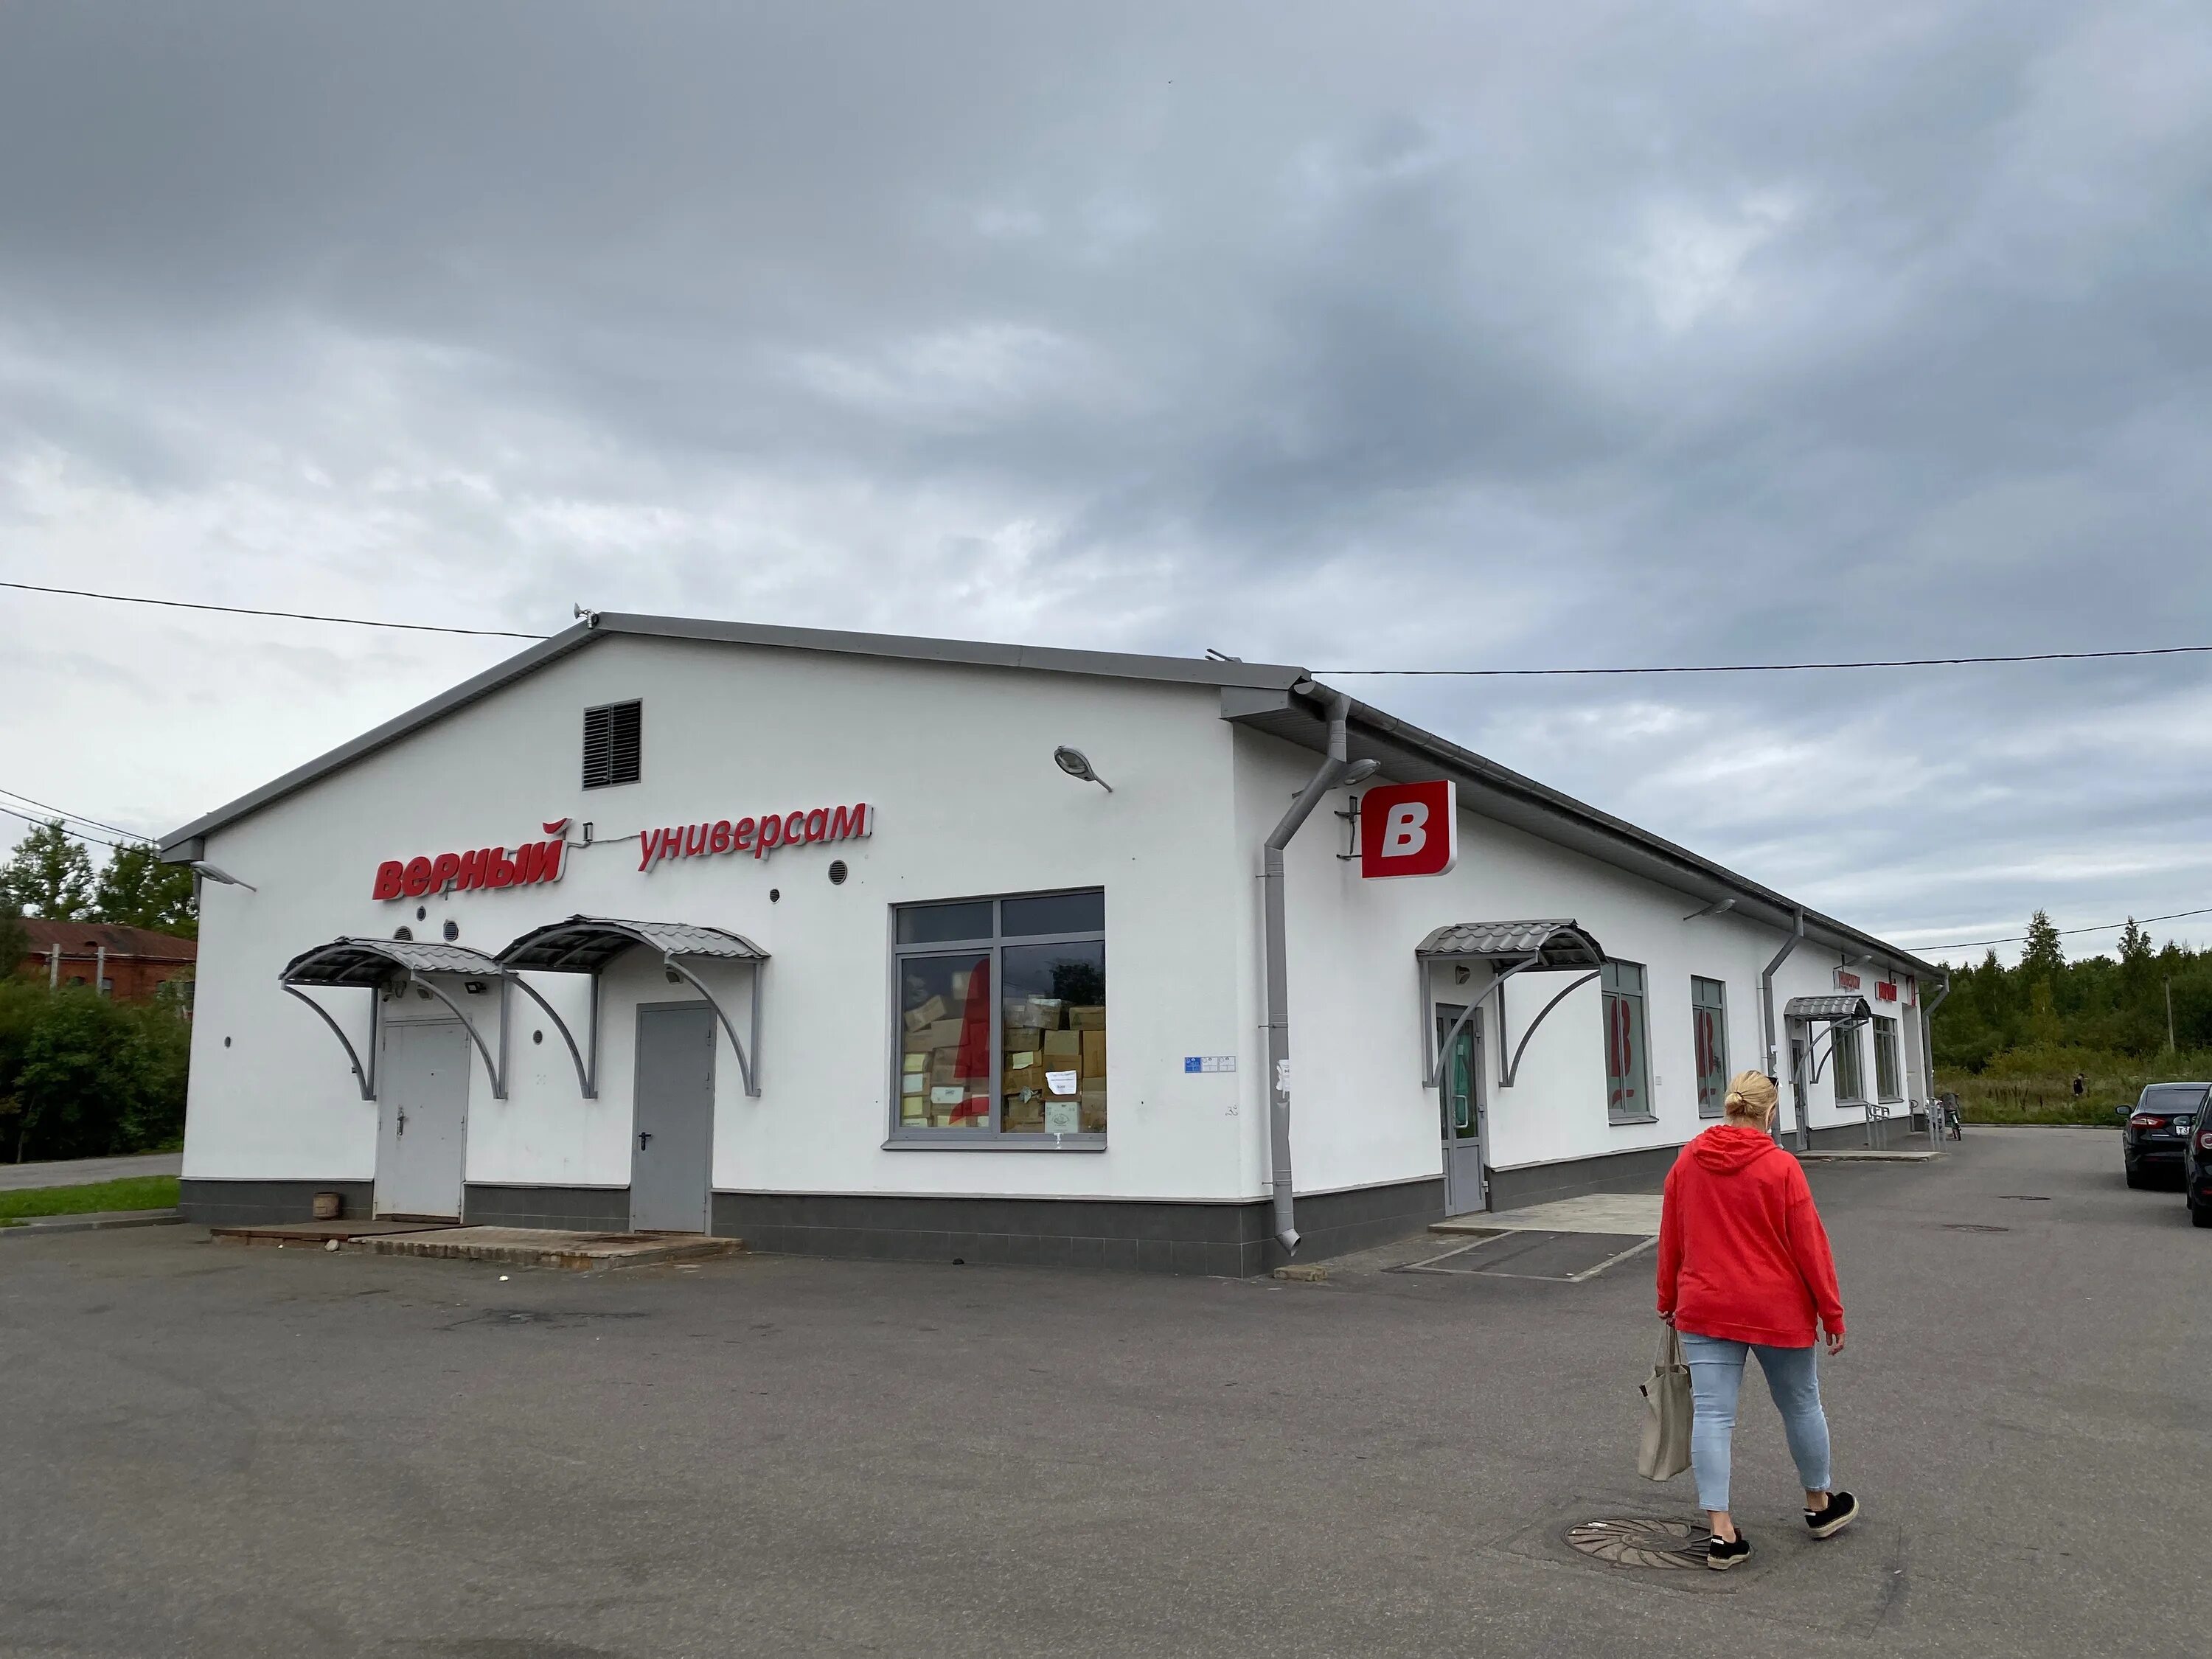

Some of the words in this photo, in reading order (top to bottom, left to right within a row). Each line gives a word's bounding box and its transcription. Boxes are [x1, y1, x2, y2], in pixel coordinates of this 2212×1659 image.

[372, 818, 565, 900] верный
[638, 803, 866, 872] универсам
[1381, 802, 1429, 858] В
